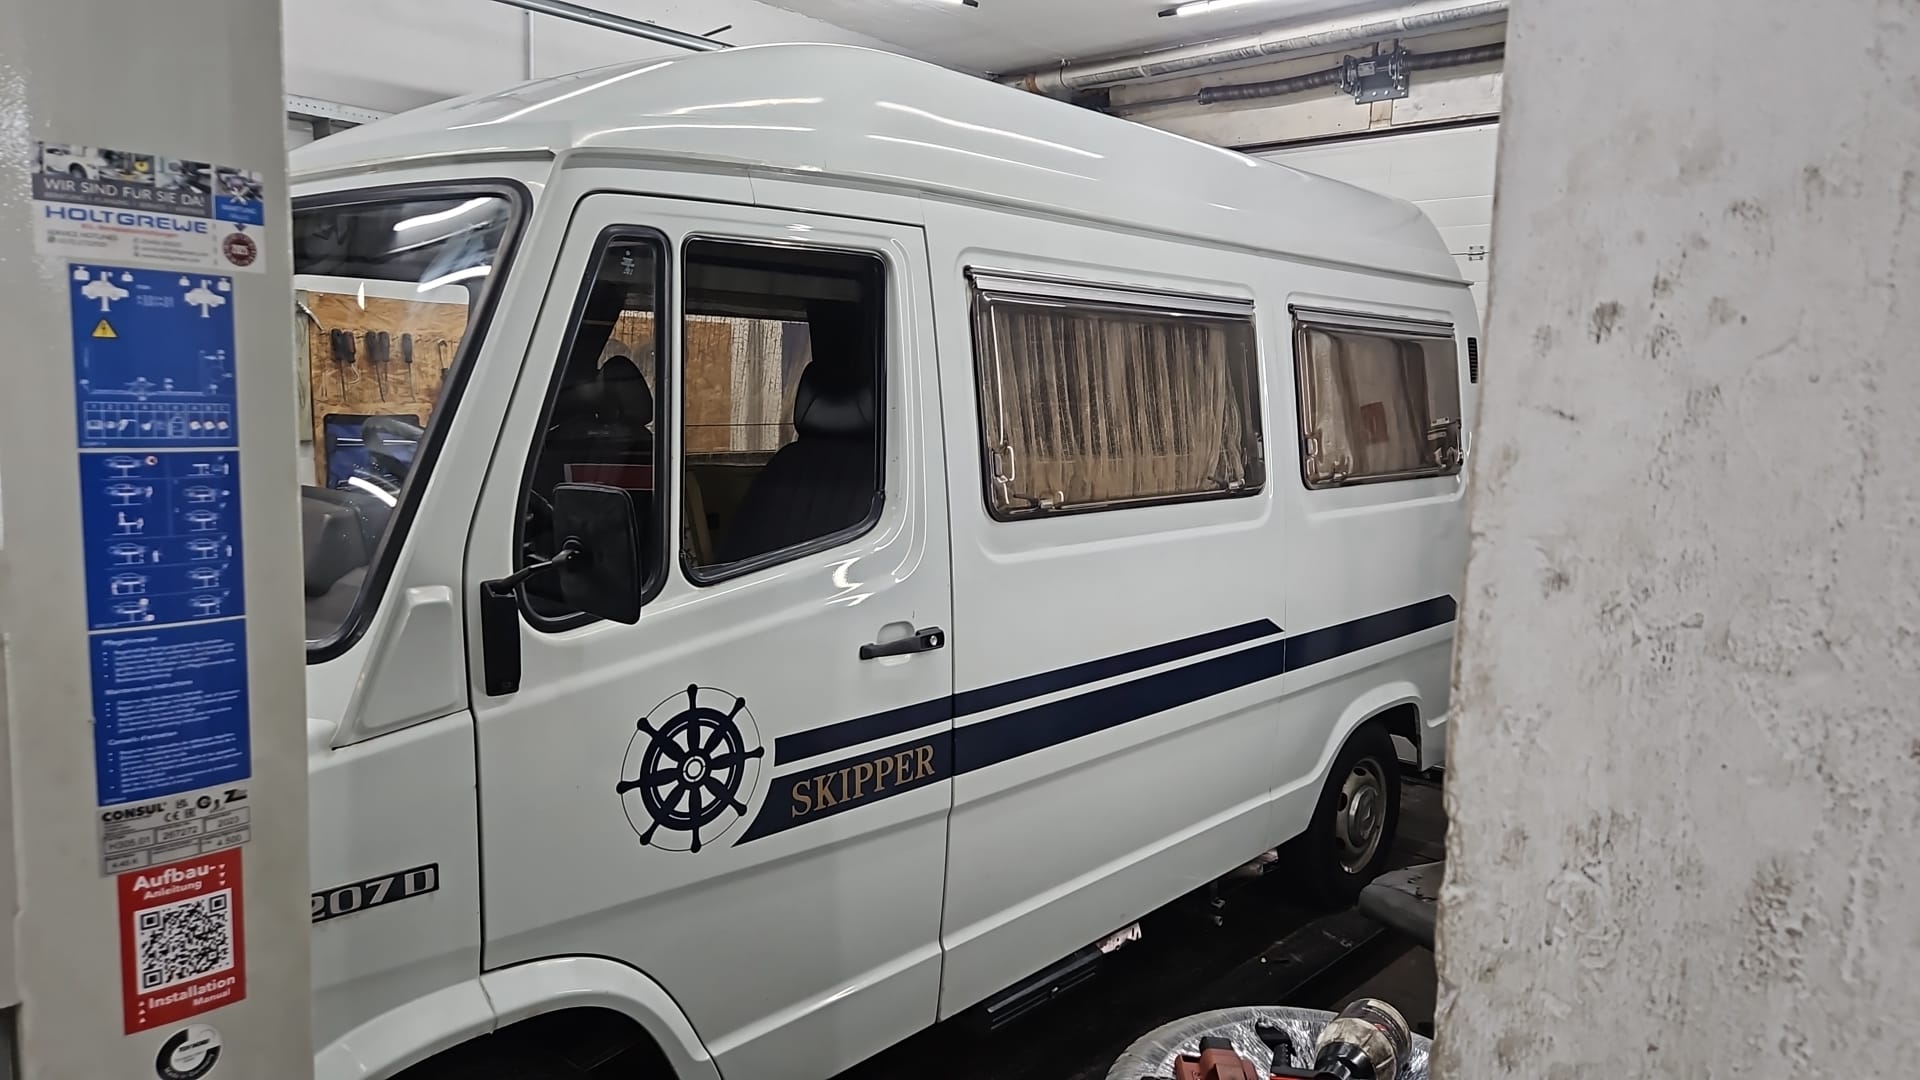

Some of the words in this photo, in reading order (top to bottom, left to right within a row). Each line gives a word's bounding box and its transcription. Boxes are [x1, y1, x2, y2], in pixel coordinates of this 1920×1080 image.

[43, 177, 76, 192] WIR
[80, 181, 118, 198] SIND
[157, 190, 178, 204] SIE
[45, 205, 208, 234] HOLTGREWE
[791, 744, 936, 819] SKIPPER
[101, 803, 164, 822] CONSUL
[132, 863, 217, 892] Aufbau-
[143, 880, 203, 900] Anleitung
[312, 877, 395, 920] 207
[404, 868, 435, 896] D
[148, 975, 236, 1009] Installation
[192, 988, 231, 1007] Manual
